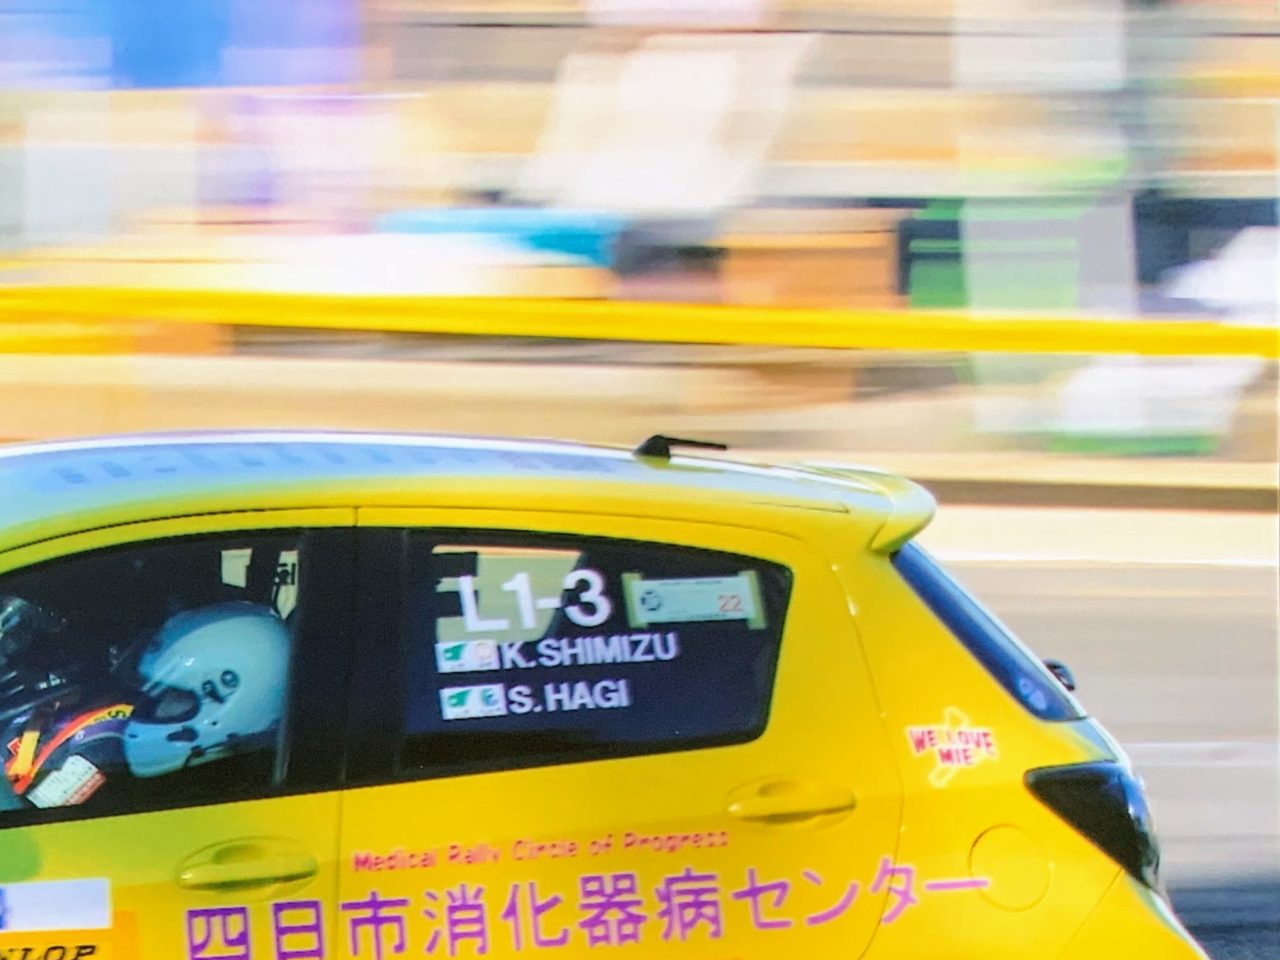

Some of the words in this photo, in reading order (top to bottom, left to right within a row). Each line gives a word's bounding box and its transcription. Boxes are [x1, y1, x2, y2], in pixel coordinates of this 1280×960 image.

[458, 569, 613, 632] L1-3
[718, 593, 742, 612] 22
[501, 632, 678, 670] K.SHIMIZU
[507, 680, 631, 714] S.HAGI
[354, 849, 437, 871] Medical
[447, 842, 500, 866] Rally
[512, 838, 577, 861] Circle
[589, 833, 614, 856] of
[624, 831, 729, 852] Progress
